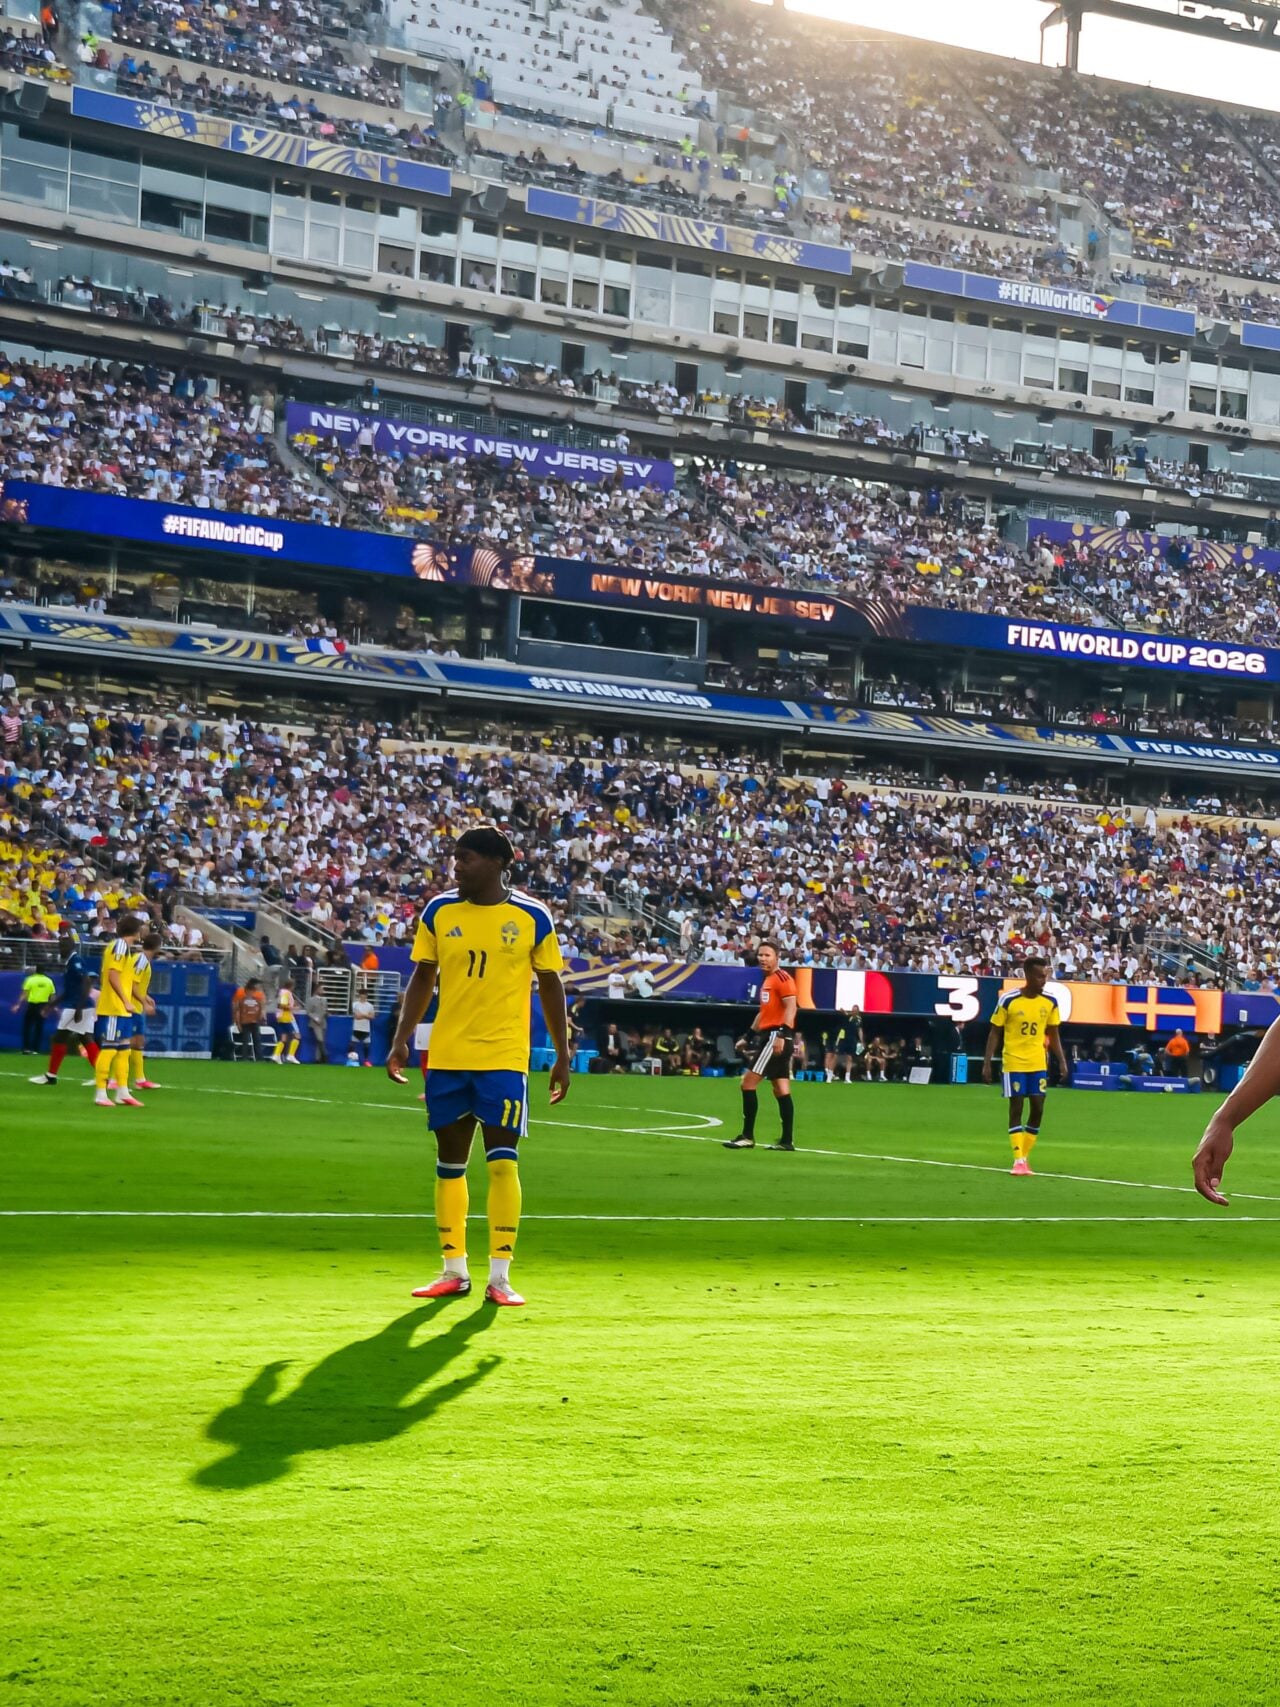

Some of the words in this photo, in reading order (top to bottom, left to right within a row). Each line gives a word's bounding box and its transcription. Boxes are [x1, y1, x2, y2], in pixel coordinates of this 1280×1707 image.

[386, 423, 467, 451] YORK
[474, 438, 539, 462] NEW
[544, 450, 653, 478] JERSEY
[163, 514, 283, 552] #FIFAWorldCup
[591, 573, 641, 596] NEW
[706, 589, 752, 612] NEW
[755, 597, 835, 622] JESEY
[1007, 624, 1056, 650] FIFA
[1058, 631, 1139, 659] WORLD
[1141, 641, 1187, 664] CUP
[1188, 648, 1265, 674] 2026
[528, 676, 712, 710] #FIFAWorldCup
[1135, 741, 1192, 756] FIFA
[1192, 746, 1279, 764] WORLD
[895, 791, 938, 803] NEW
[467, 950, 487, 978] 11
[934, 975, 980, 1022] 3
[1020, 1021, 1038, 1036] 26
[501, 1098, 521, 1129] 11
